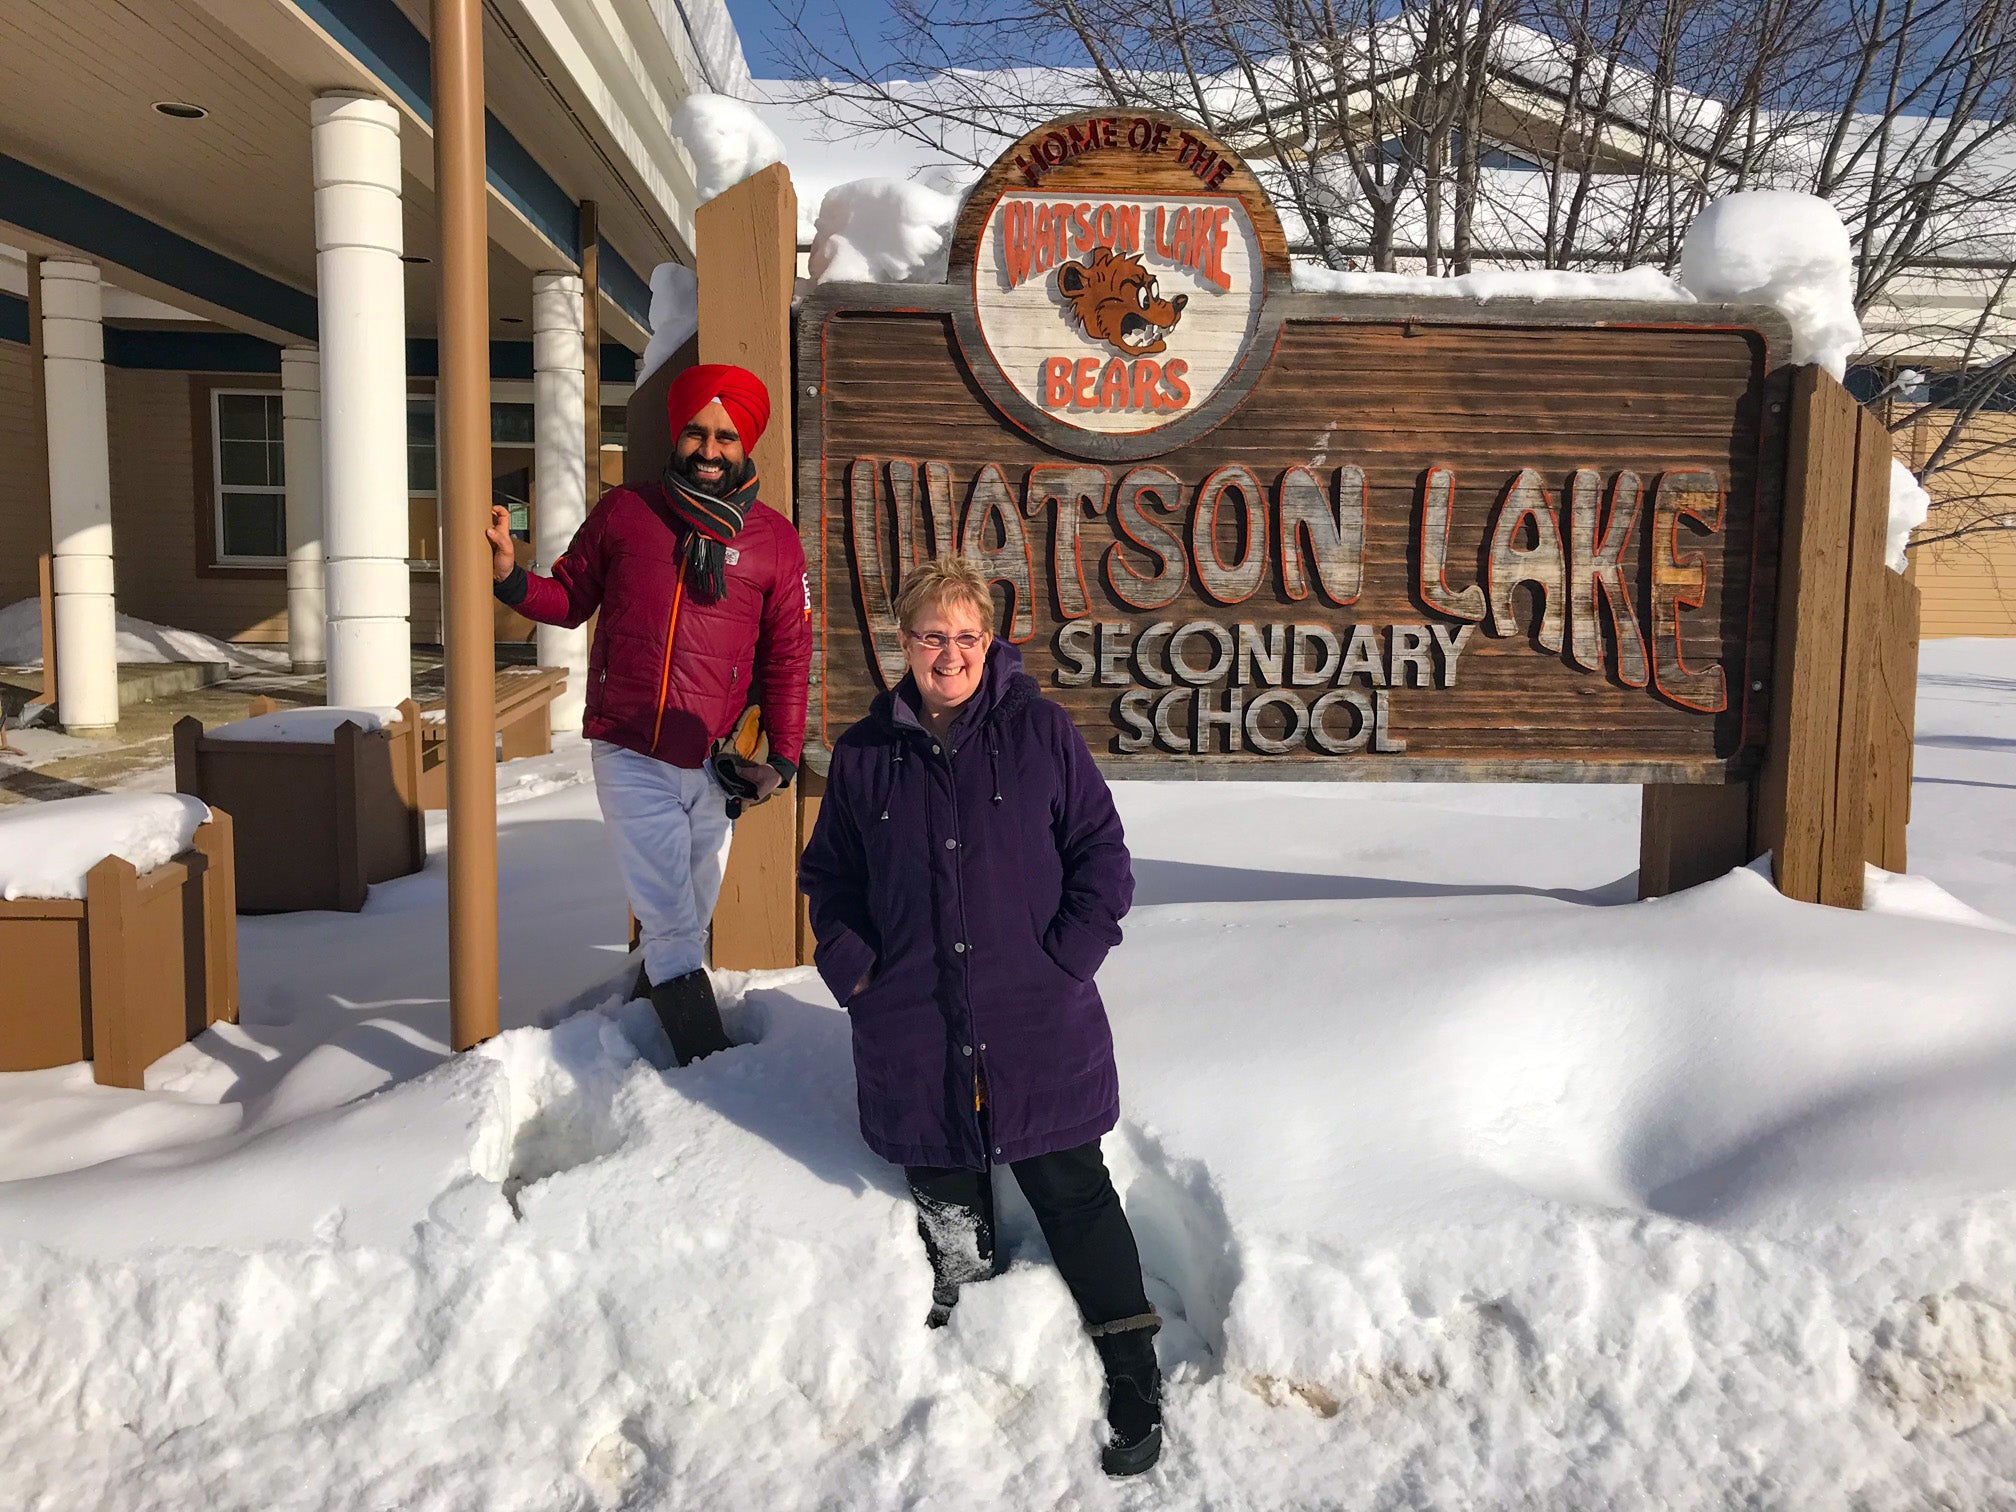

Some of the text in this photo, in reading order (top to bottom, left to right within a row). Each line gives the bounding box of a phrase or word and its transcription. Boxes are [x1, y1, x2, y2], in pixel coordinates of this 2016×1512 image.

[1015, 117, 1234, 190] HOME OF THE
[1003, 200, 1231, 292] WATSON LAKE
[1045, 356, 1191, 409] BEARS
[851, 457, 1727, 713] WATSON LAKE
[1057, 620, 1477, 687] SECONDARY
[1118, 687, 1407, 754] SCHOOL
